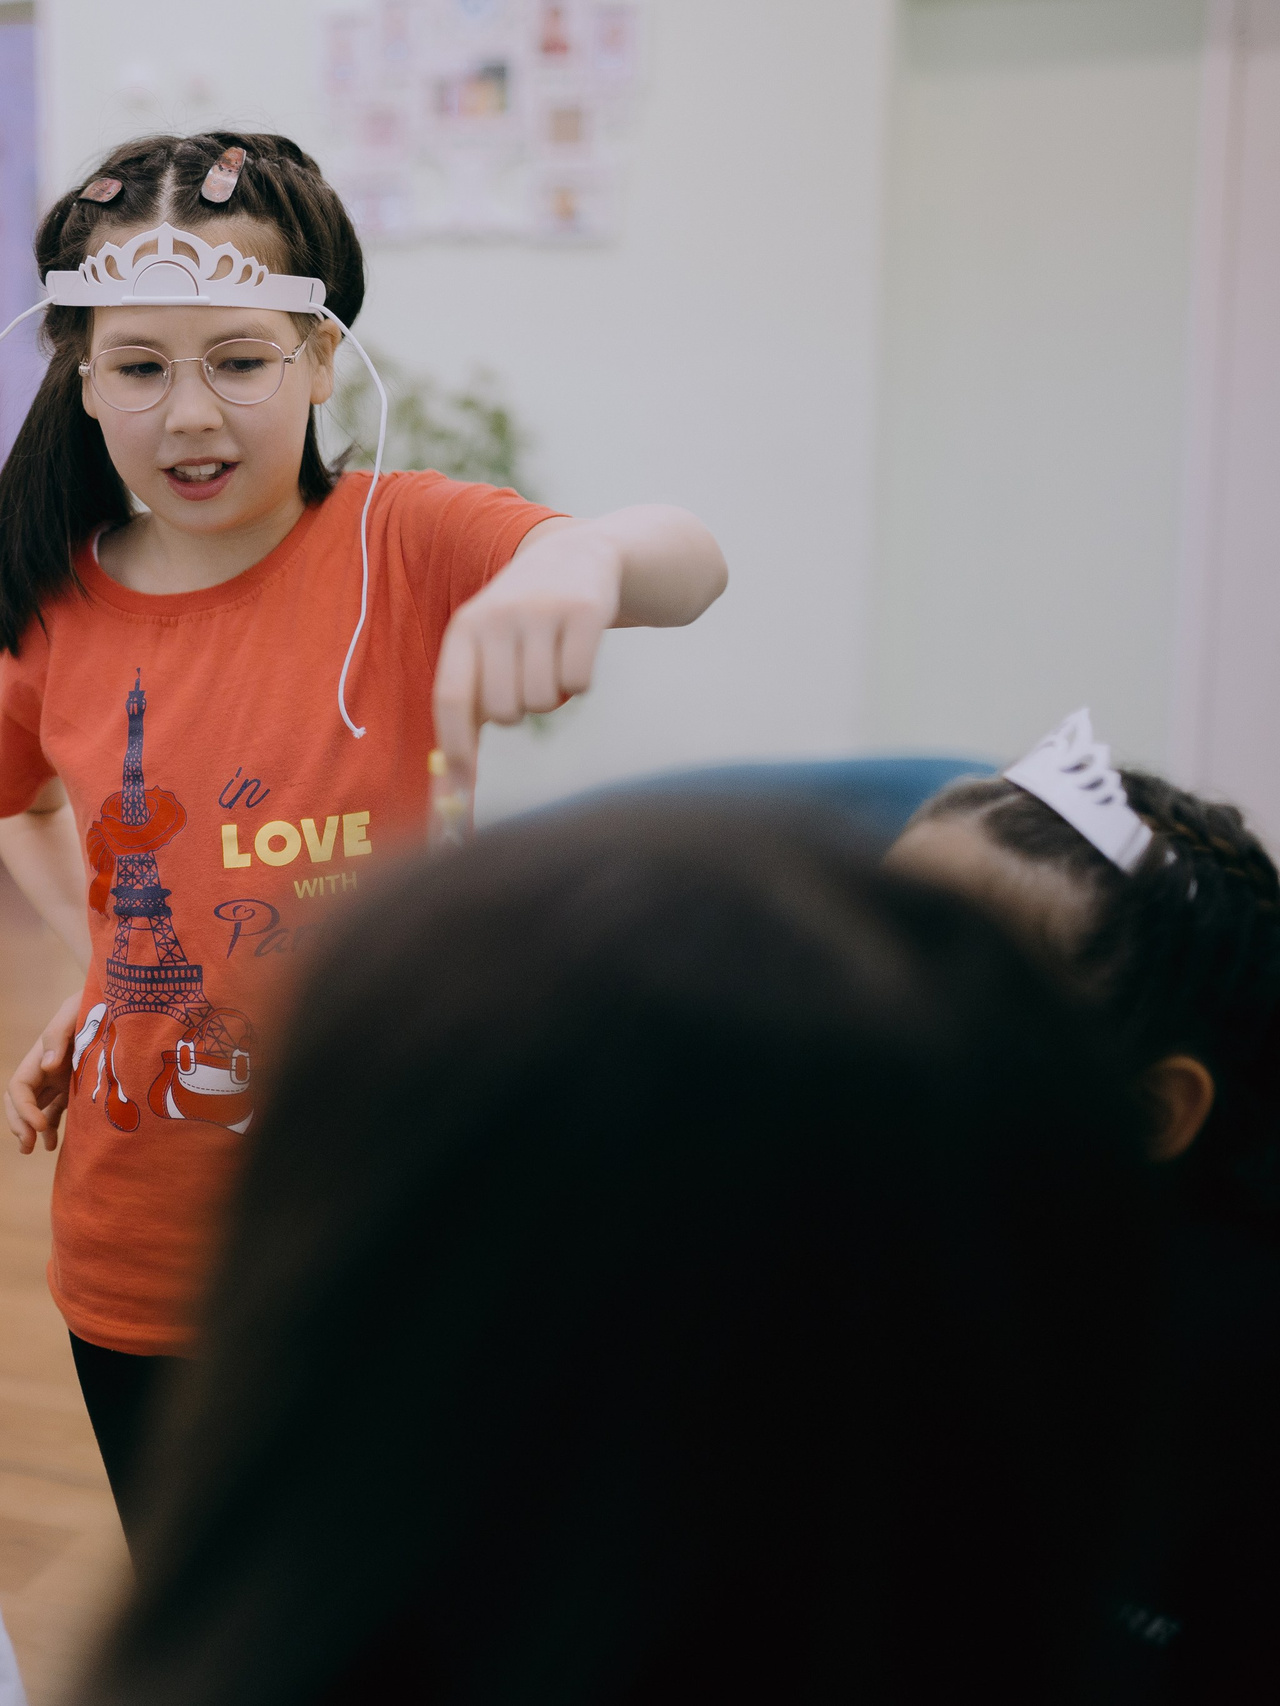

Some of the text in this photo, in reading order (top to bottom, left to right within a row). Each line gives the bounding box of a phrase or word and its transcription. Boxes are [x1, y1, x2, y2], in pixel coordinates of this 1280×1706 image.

[218, 766, 271, 809] in
[221, 810, 372, 869] LOVE
[293, 871, 358, 899] WITH
